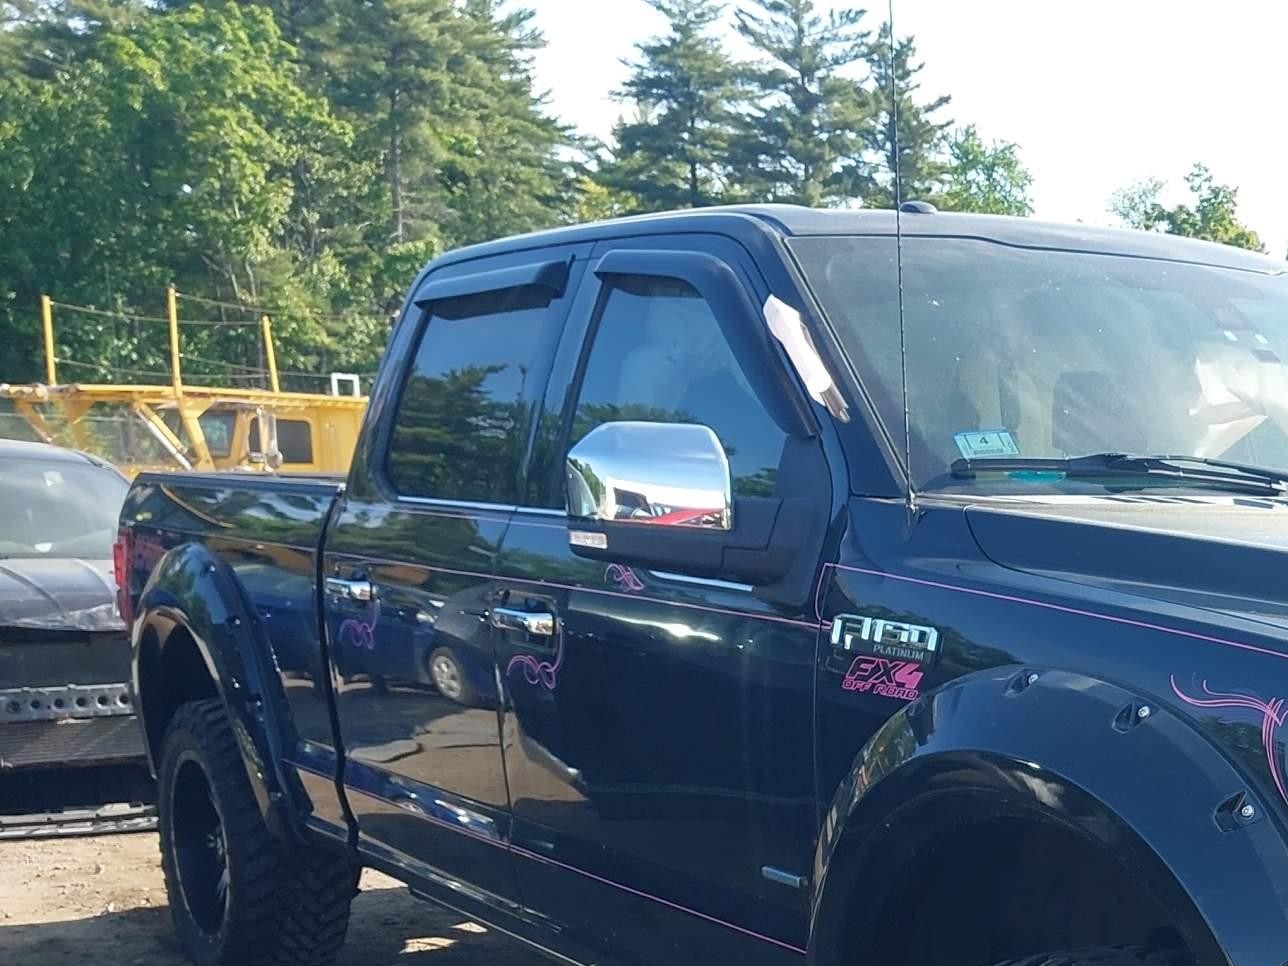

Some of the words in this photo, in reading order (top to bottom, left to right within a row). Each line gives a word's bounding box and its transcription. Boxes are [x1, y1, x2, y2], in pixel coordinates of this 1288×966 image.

[873, 644, 924, 661] PLATINUM
[847, 655, 924, 689] FX4
[842, 680, 873, 692] OFF
[873, 685, 918, 700] ROAD
